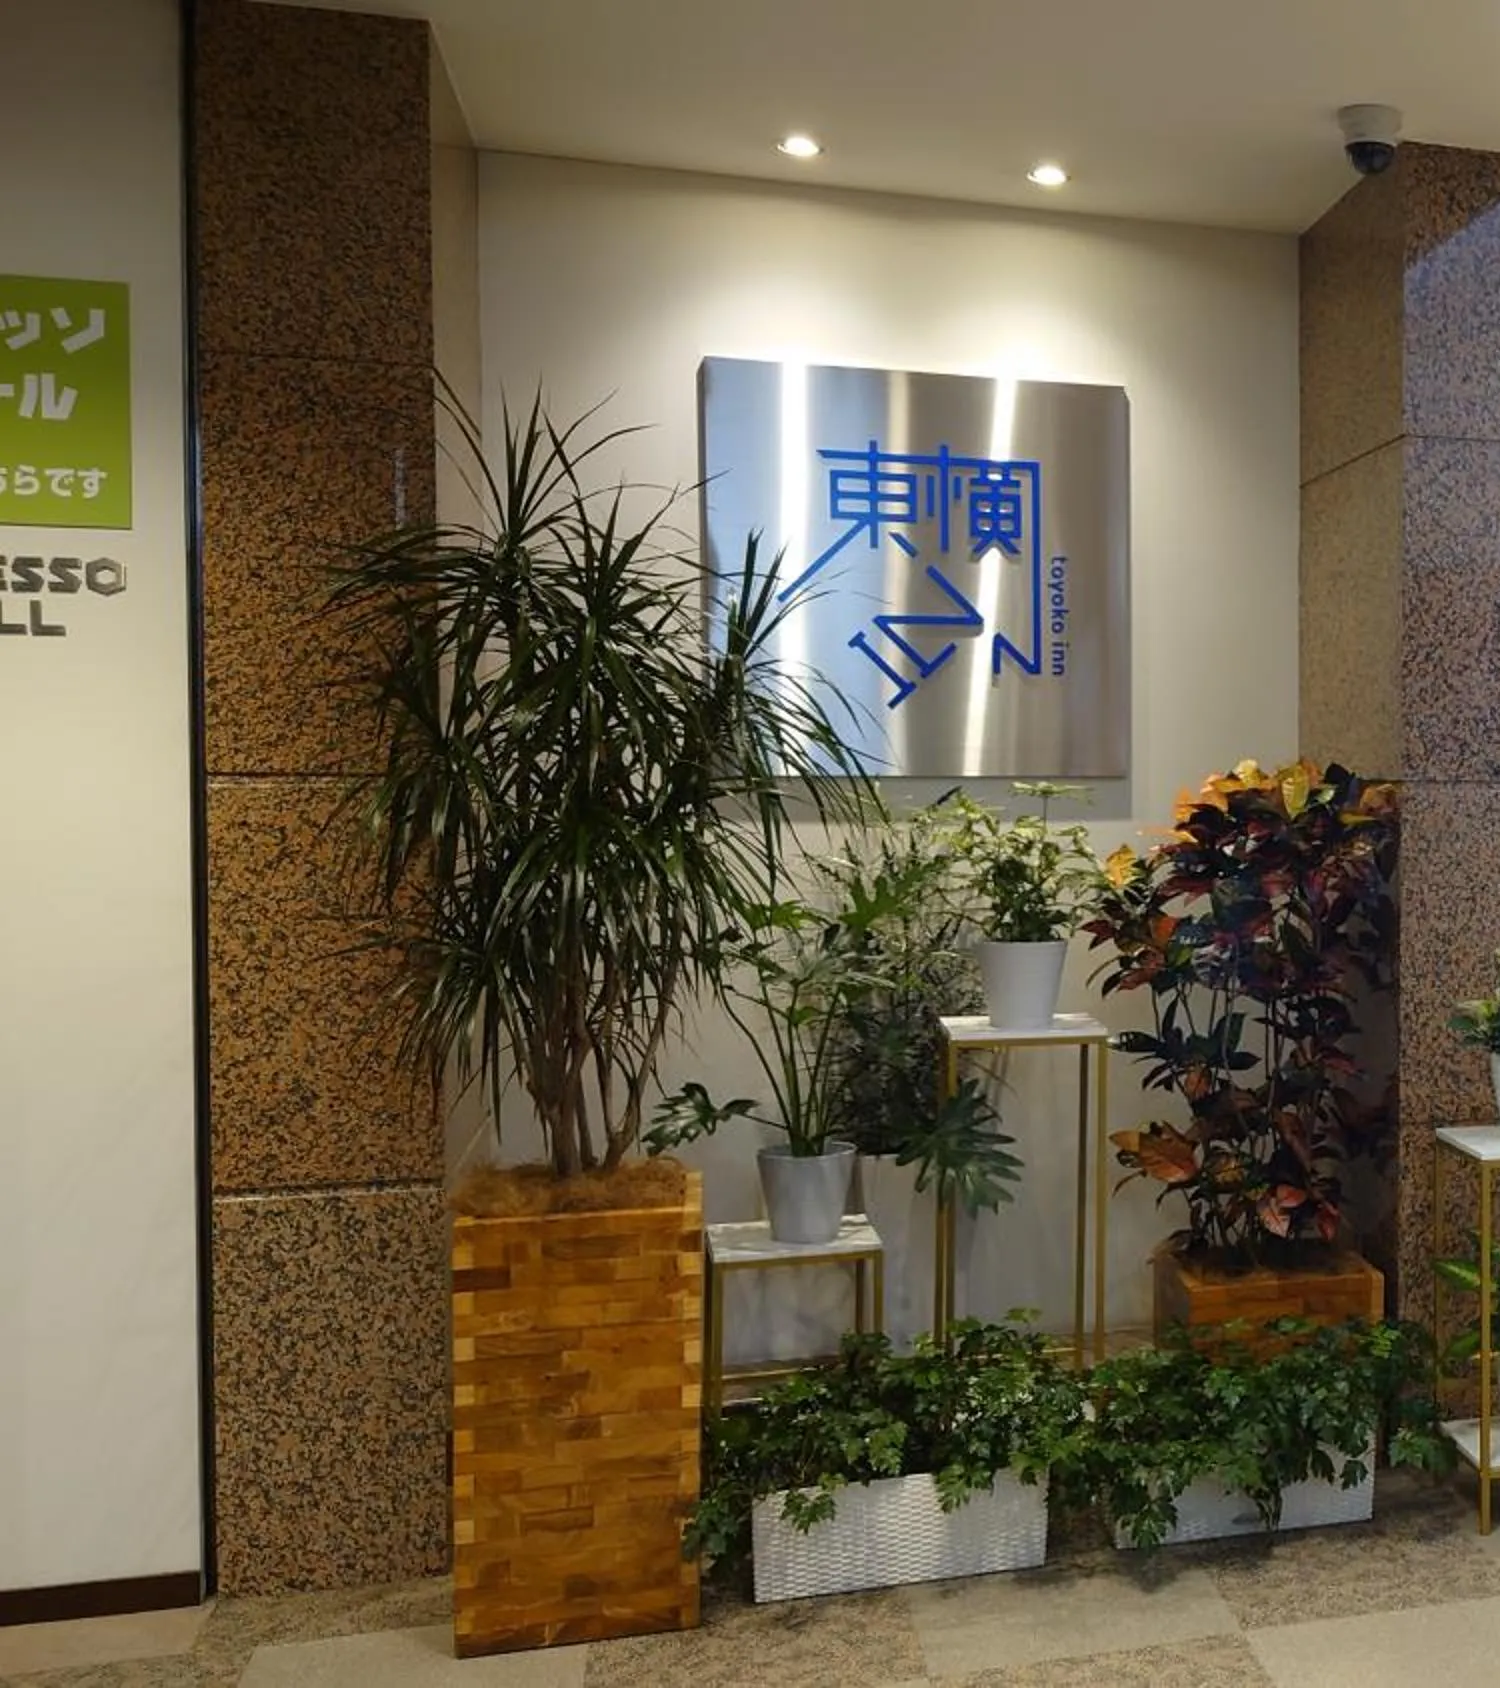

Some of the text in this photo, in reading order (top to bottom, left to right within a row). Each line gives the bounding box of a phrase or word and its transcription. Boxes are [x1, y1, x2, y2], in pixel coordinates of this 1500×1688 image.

[0, 372, 78, 421] ル
[0, 465, 108, 498] らです
[0, 556, 127, 597] SSO
[1047, 557, 1070, 676] toyoko inn
